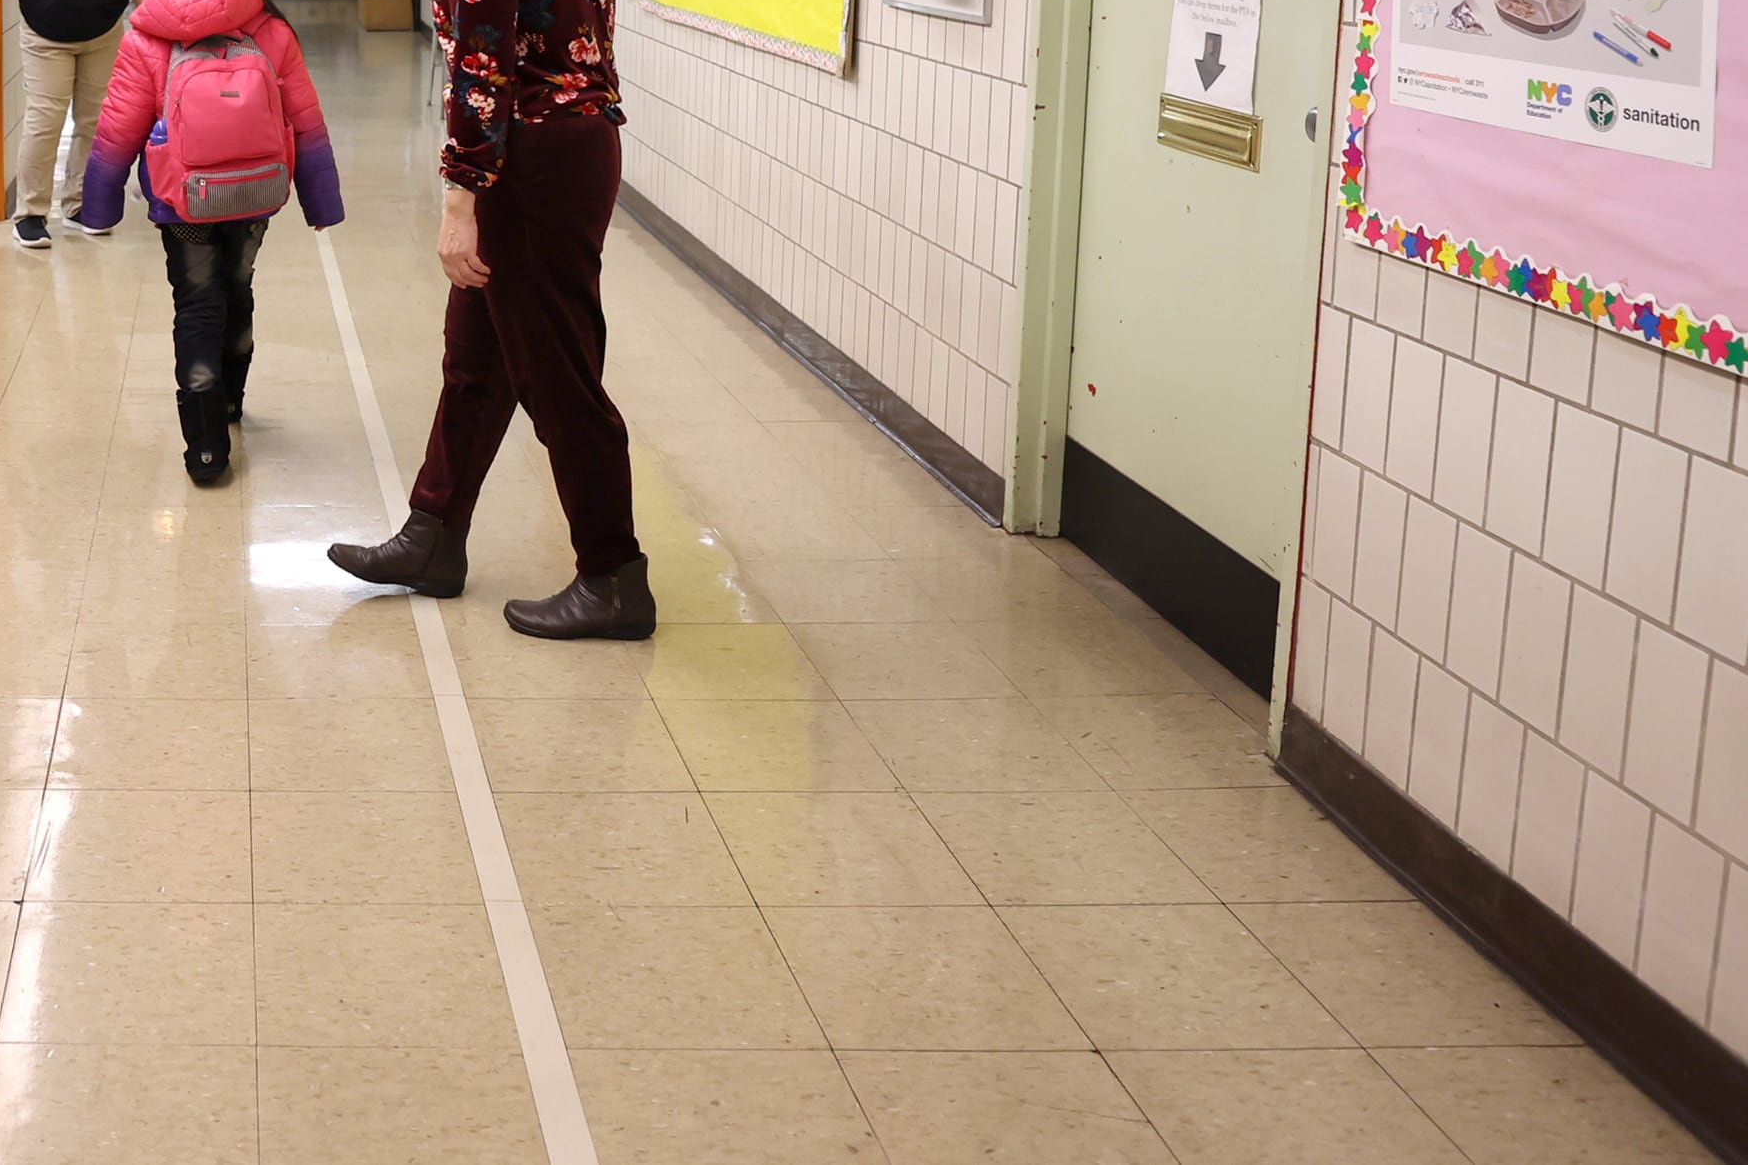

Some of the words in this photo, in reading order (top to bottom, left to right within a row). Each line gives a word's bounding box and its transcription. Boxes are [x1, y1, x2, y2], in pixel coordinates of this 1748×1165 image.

[1527, 78, 1573, 107] NYC
[1526, 101, 1556, 113] Department
[1526, 109, 1552, 120] Education
[1623, 106, 1701, 133] sanitation
